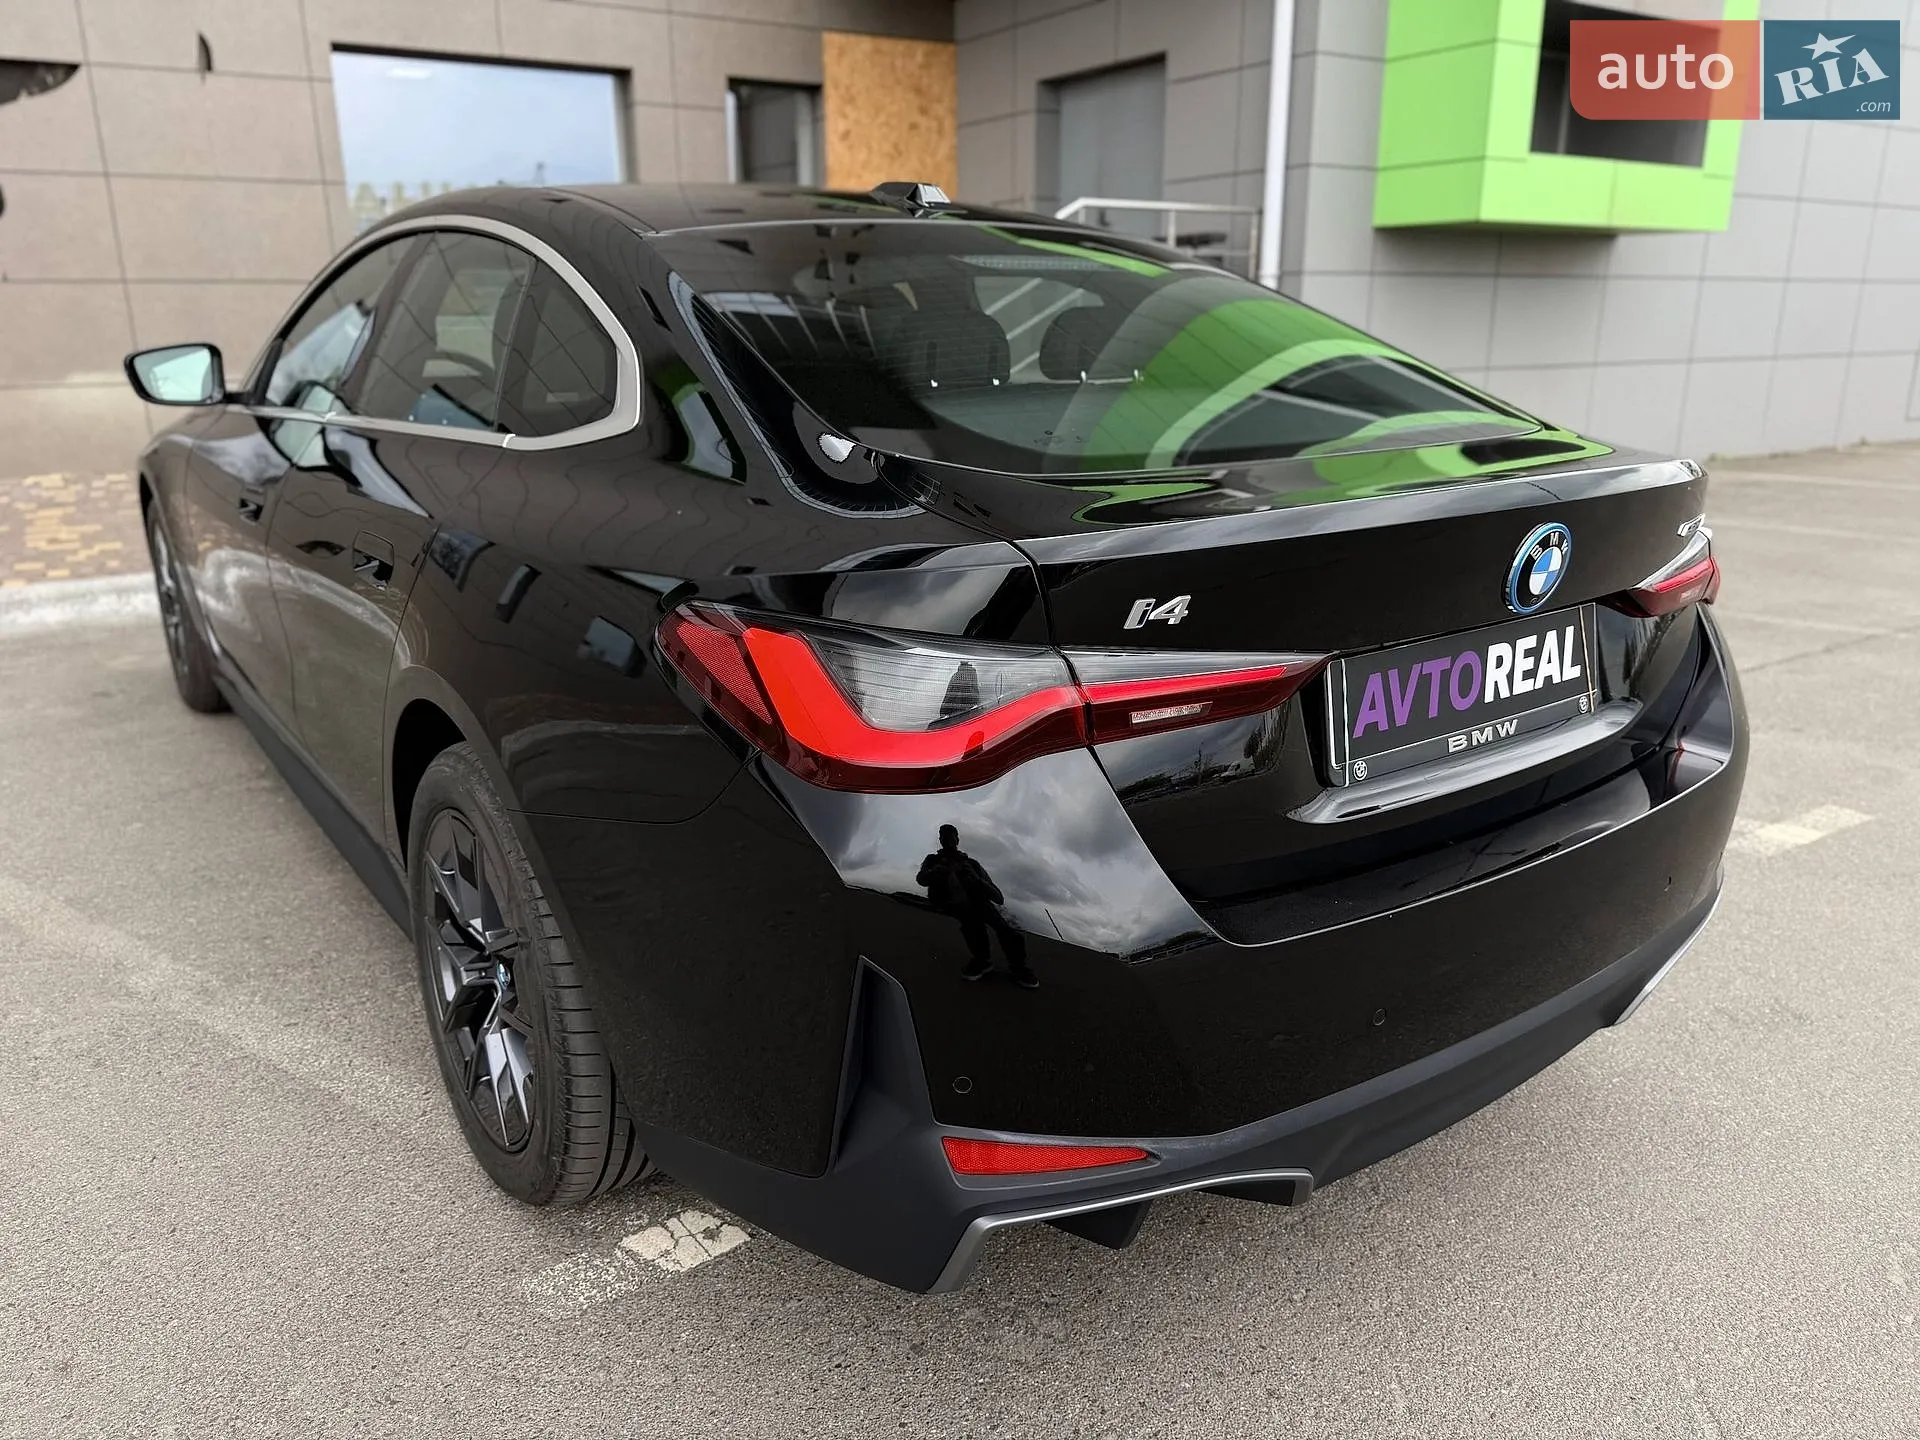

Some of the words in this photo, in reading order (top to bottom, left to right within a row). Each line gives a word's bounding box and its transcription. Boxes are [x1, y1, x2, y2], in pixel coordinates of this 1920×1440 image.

[1530, 531, 1569, 561] BMW
[1123, 594, 1191, 630] i4
[1352, 625, 1581, 738] AVTOREAL
[1447, 718, 1519, 753] BMW
